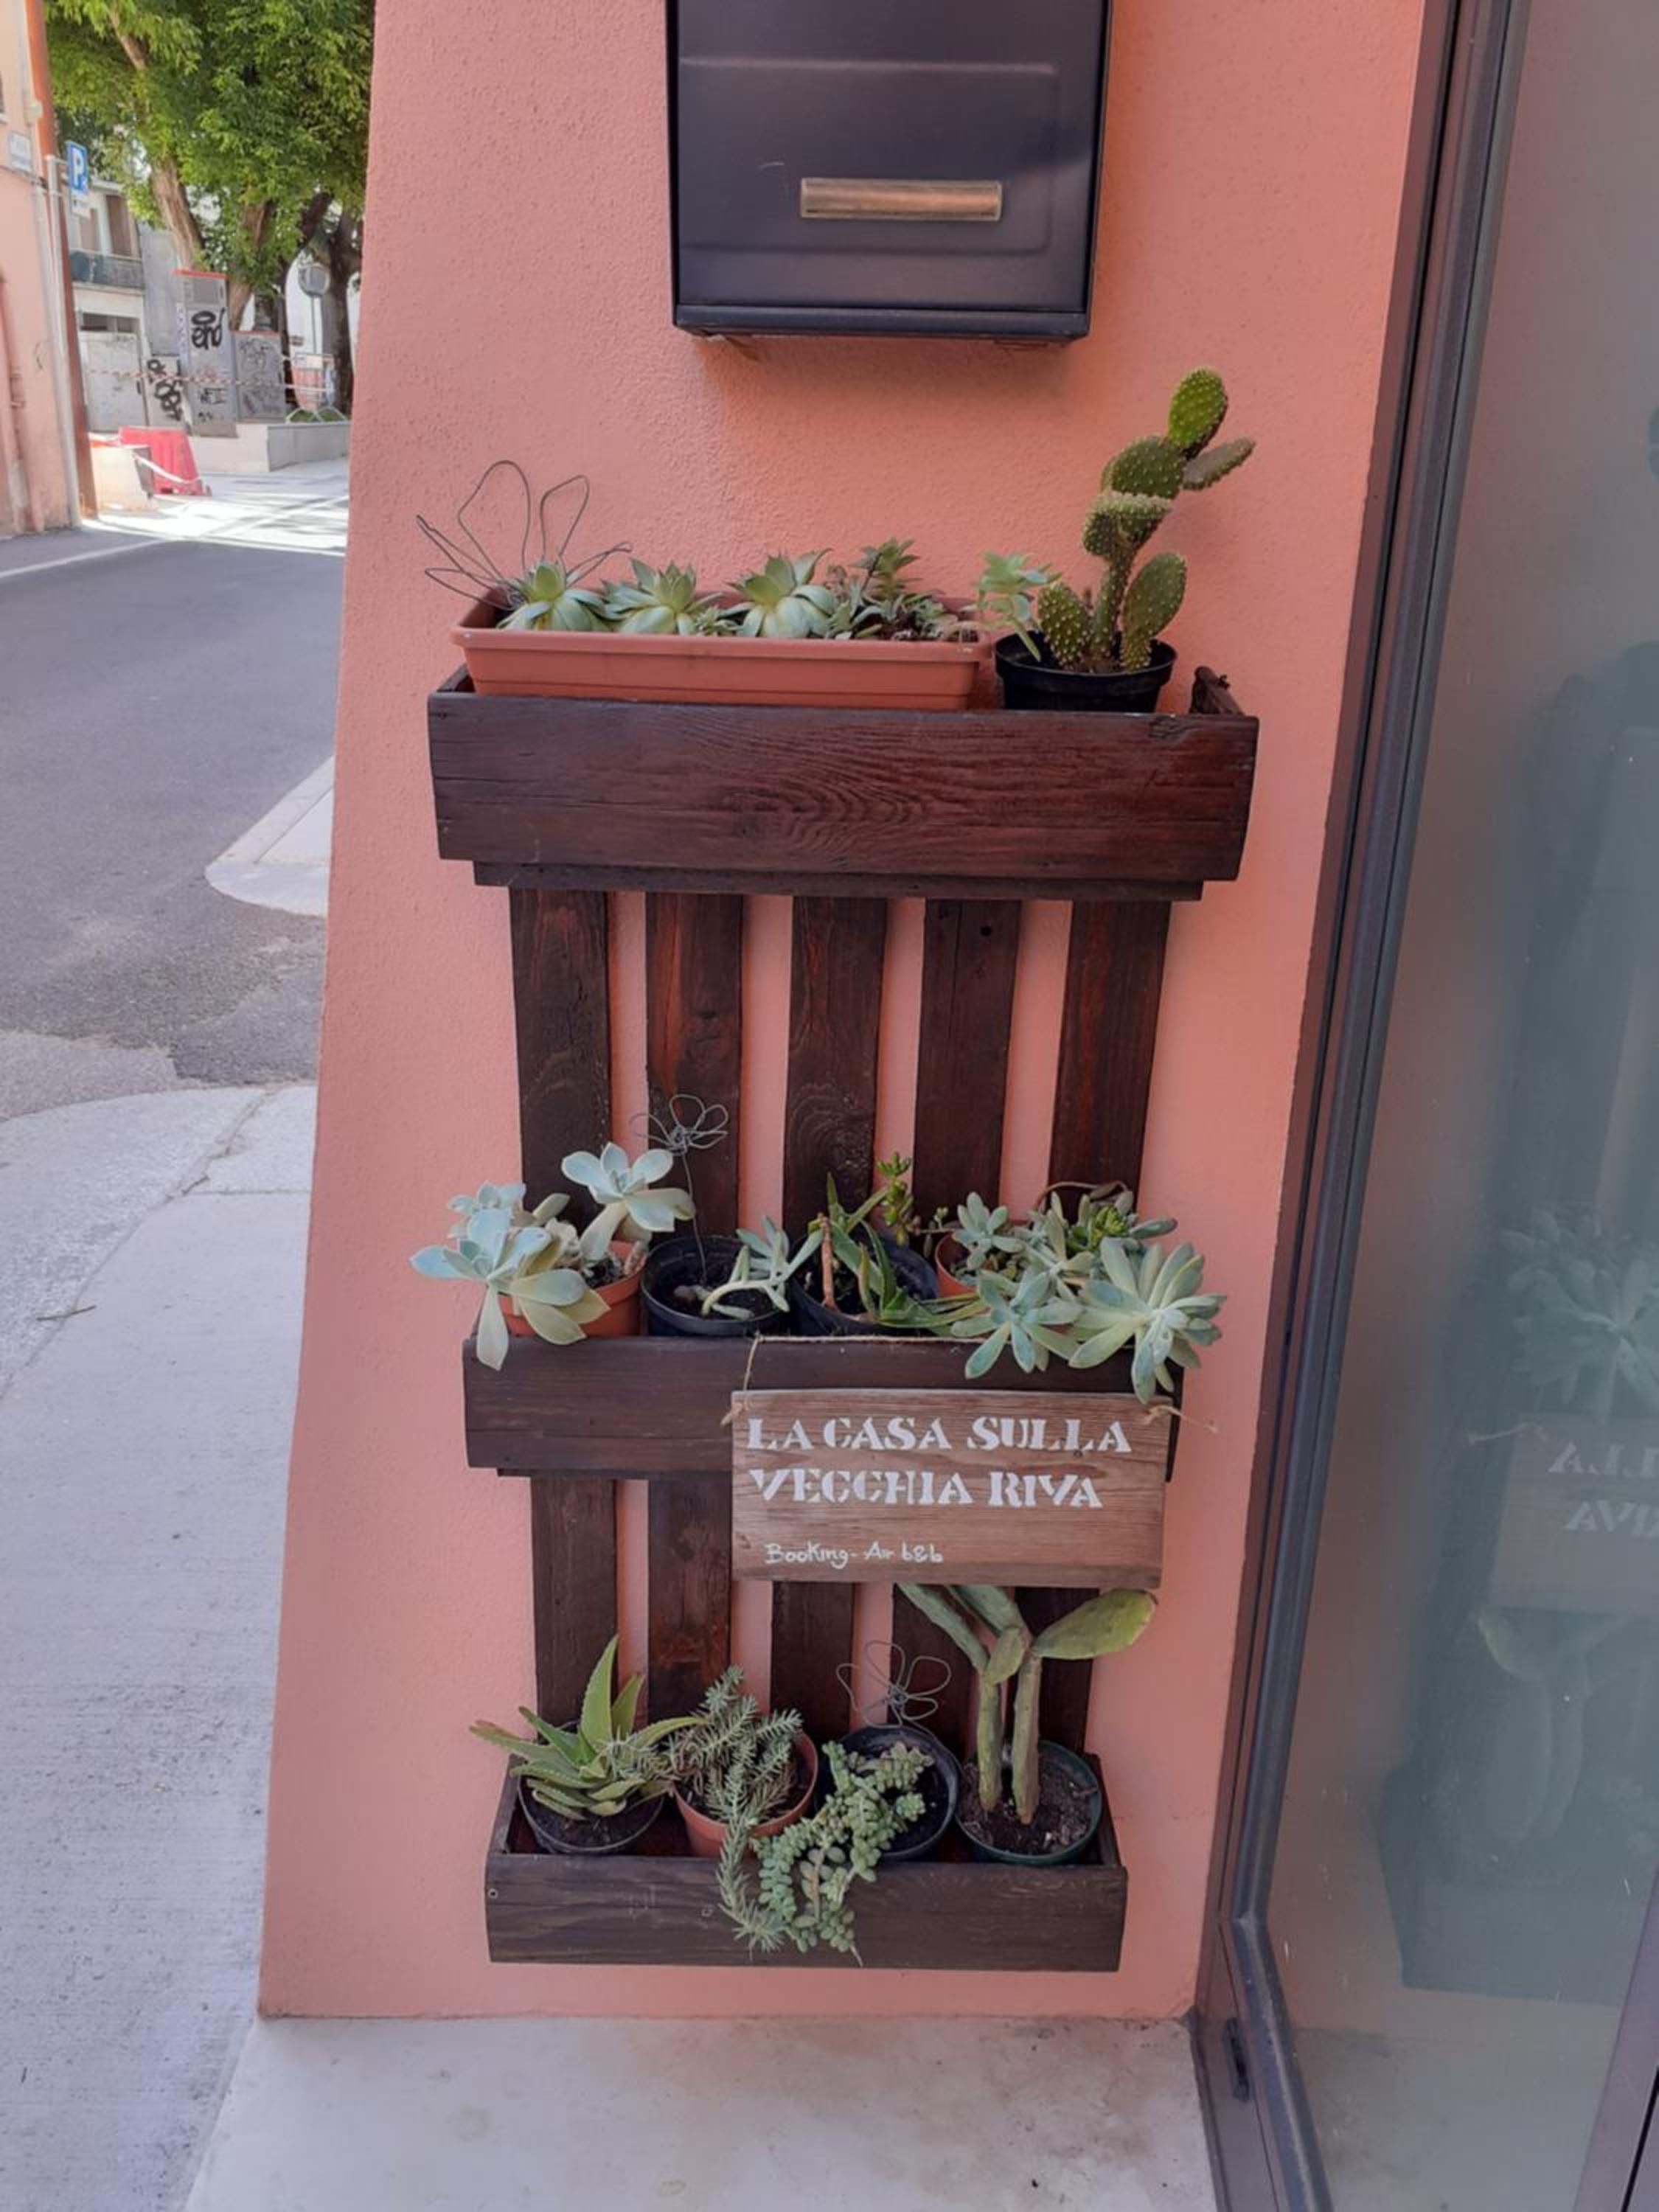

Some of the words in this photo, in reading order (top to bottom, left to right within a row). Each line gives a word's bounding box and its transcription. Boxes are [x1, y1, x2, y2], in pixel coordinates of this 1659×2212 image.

[72, 147, 85, 187] P
[747, 1418, 813, 1450] LA
[824, 1416, 953, 1450] CASA
[967, 1416, 1132, 1453] SULLA
[749, 1469, 973, 1505] VECCHIA
[989, 1472, 1102, 1507] RIVA
